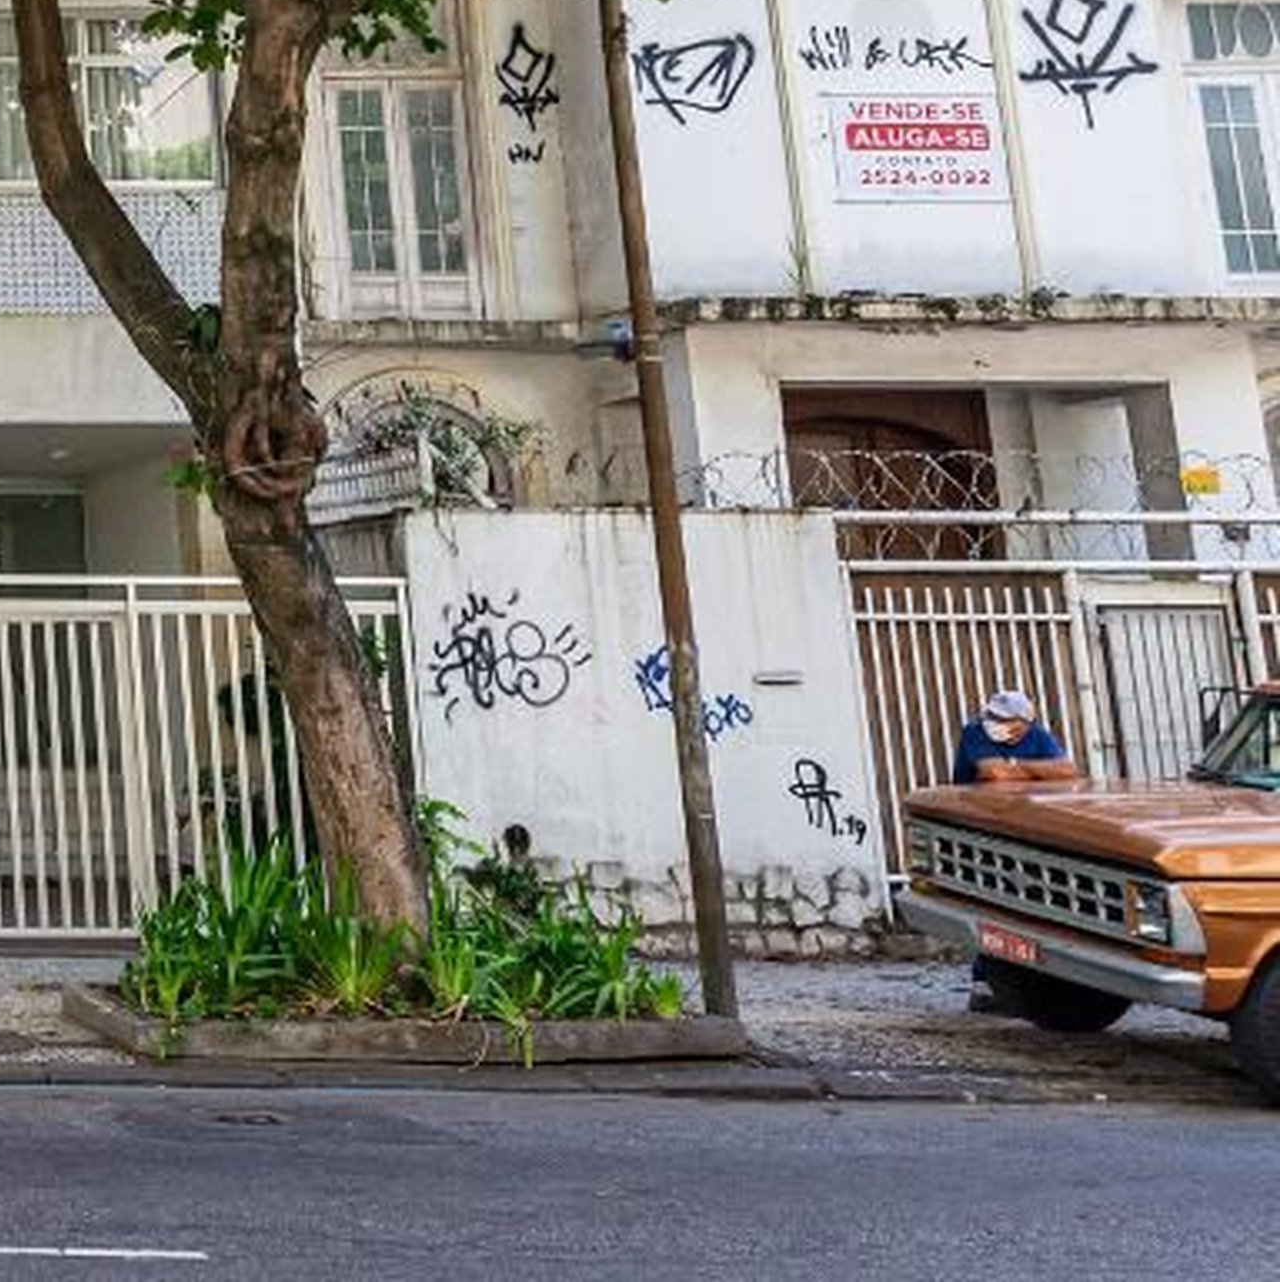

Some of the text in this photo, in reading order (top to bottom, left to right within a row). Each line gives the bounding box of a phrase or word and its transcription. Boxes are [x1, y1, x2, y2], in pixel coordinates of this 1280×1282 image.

[848, 102, 982, 120] VENDE-SE
[853, 127, 987, 147] ALUGA-SE
[875, 156, 957, 167] CONTATO
